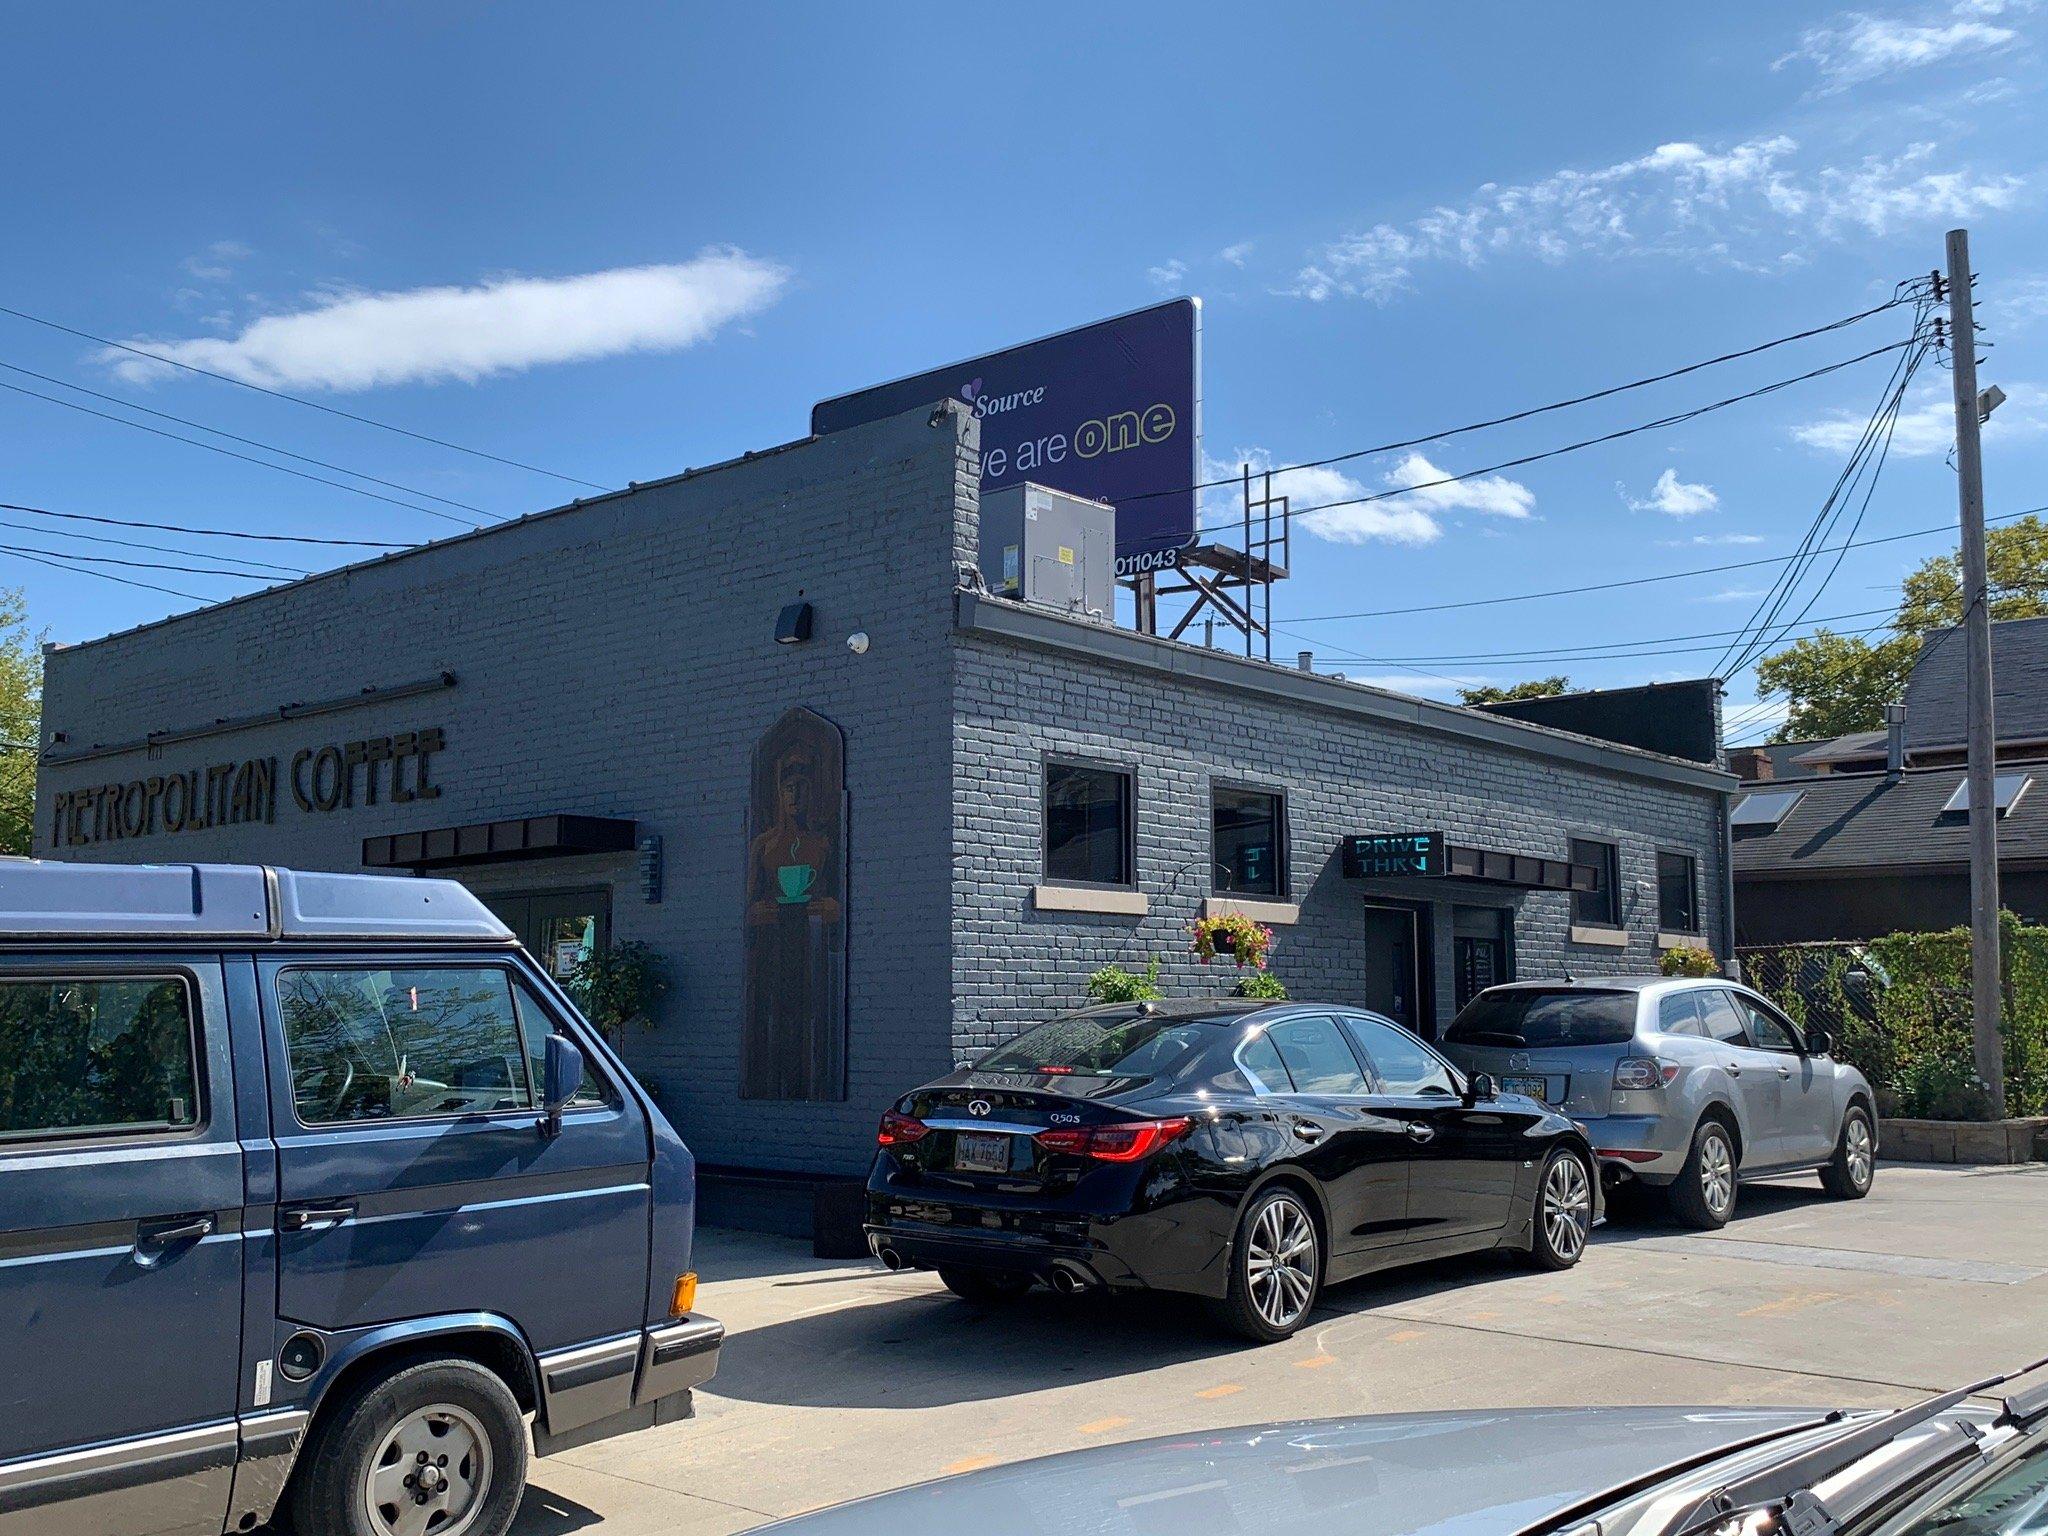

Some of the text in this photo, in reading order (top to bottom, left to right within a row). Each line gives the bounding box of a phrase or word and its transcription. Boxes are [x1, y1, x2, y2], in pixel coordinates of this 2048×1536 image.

[974, 385, 1045, 418] Source
[980, 403, 1176, 480] e are one
[1115, 549, 1176, 575] 011043
[52, 728, 447, 848] METROPOLITAN COFFEE
[1355, 837, 1430, 854] DRIVE
[1357, 857, 1427, 872] THRU
[1050, 1113, 1080, 1124] Q50S
